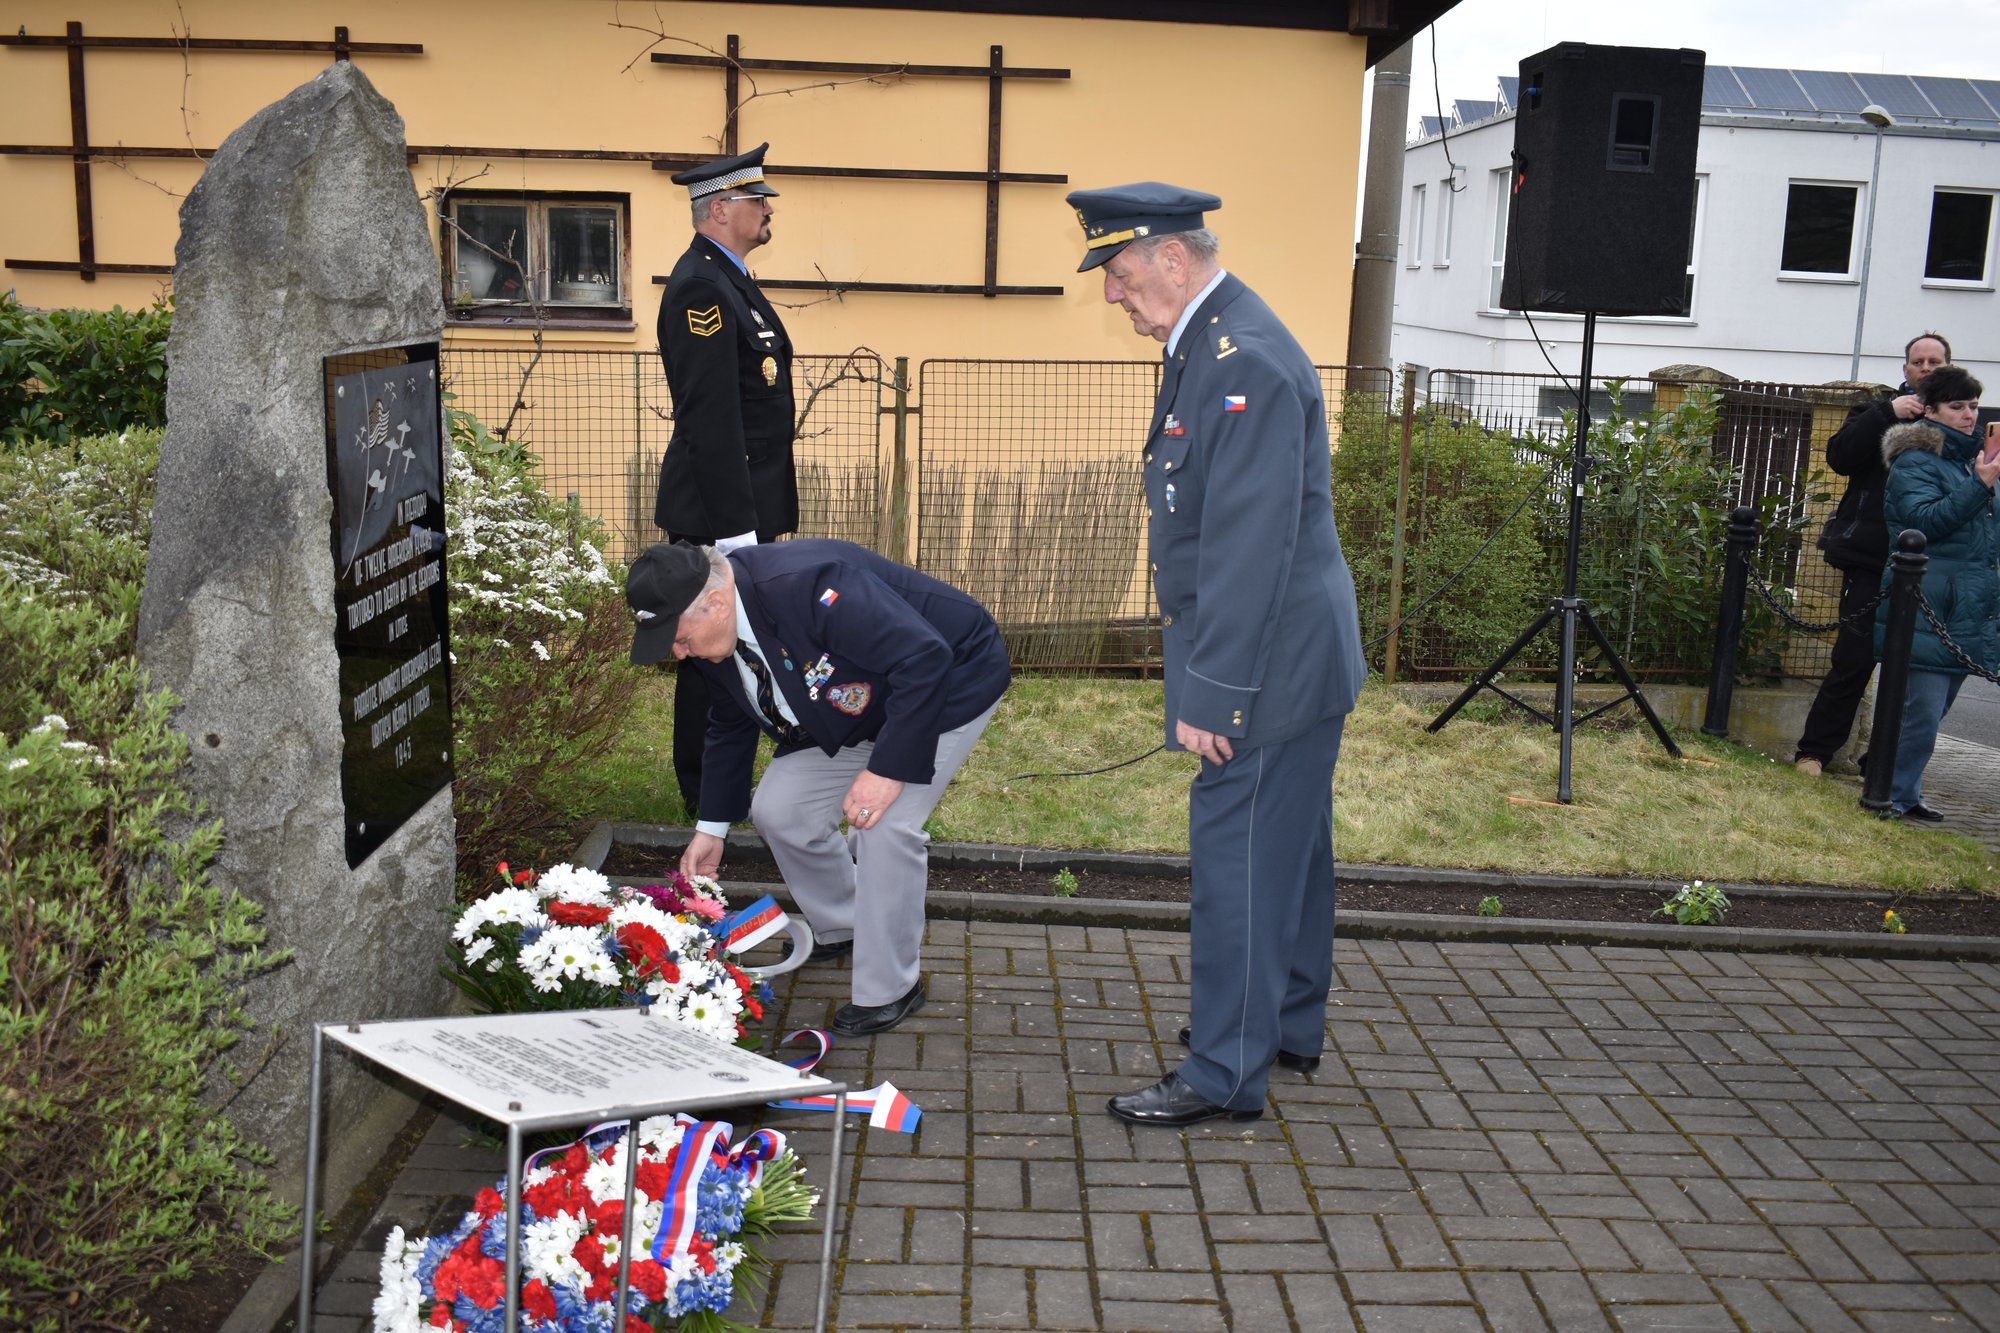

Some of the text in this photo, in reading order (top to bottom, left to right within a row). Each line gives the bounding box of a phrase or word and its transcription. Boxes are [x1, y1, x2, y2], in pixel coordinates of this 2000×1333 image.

[397, 502, 404, 527] IN
[355, 559, 363, 586] OF
[364, 548, 386, 581] TWELVE
[387, 537, 414, 570] AMERICAN
[347, 559, 440, 631] TORTURED TO DEATH BY THE GERMANS
[388, 622, 395, 643] IN
[395, 735, 412, 769] 1945
